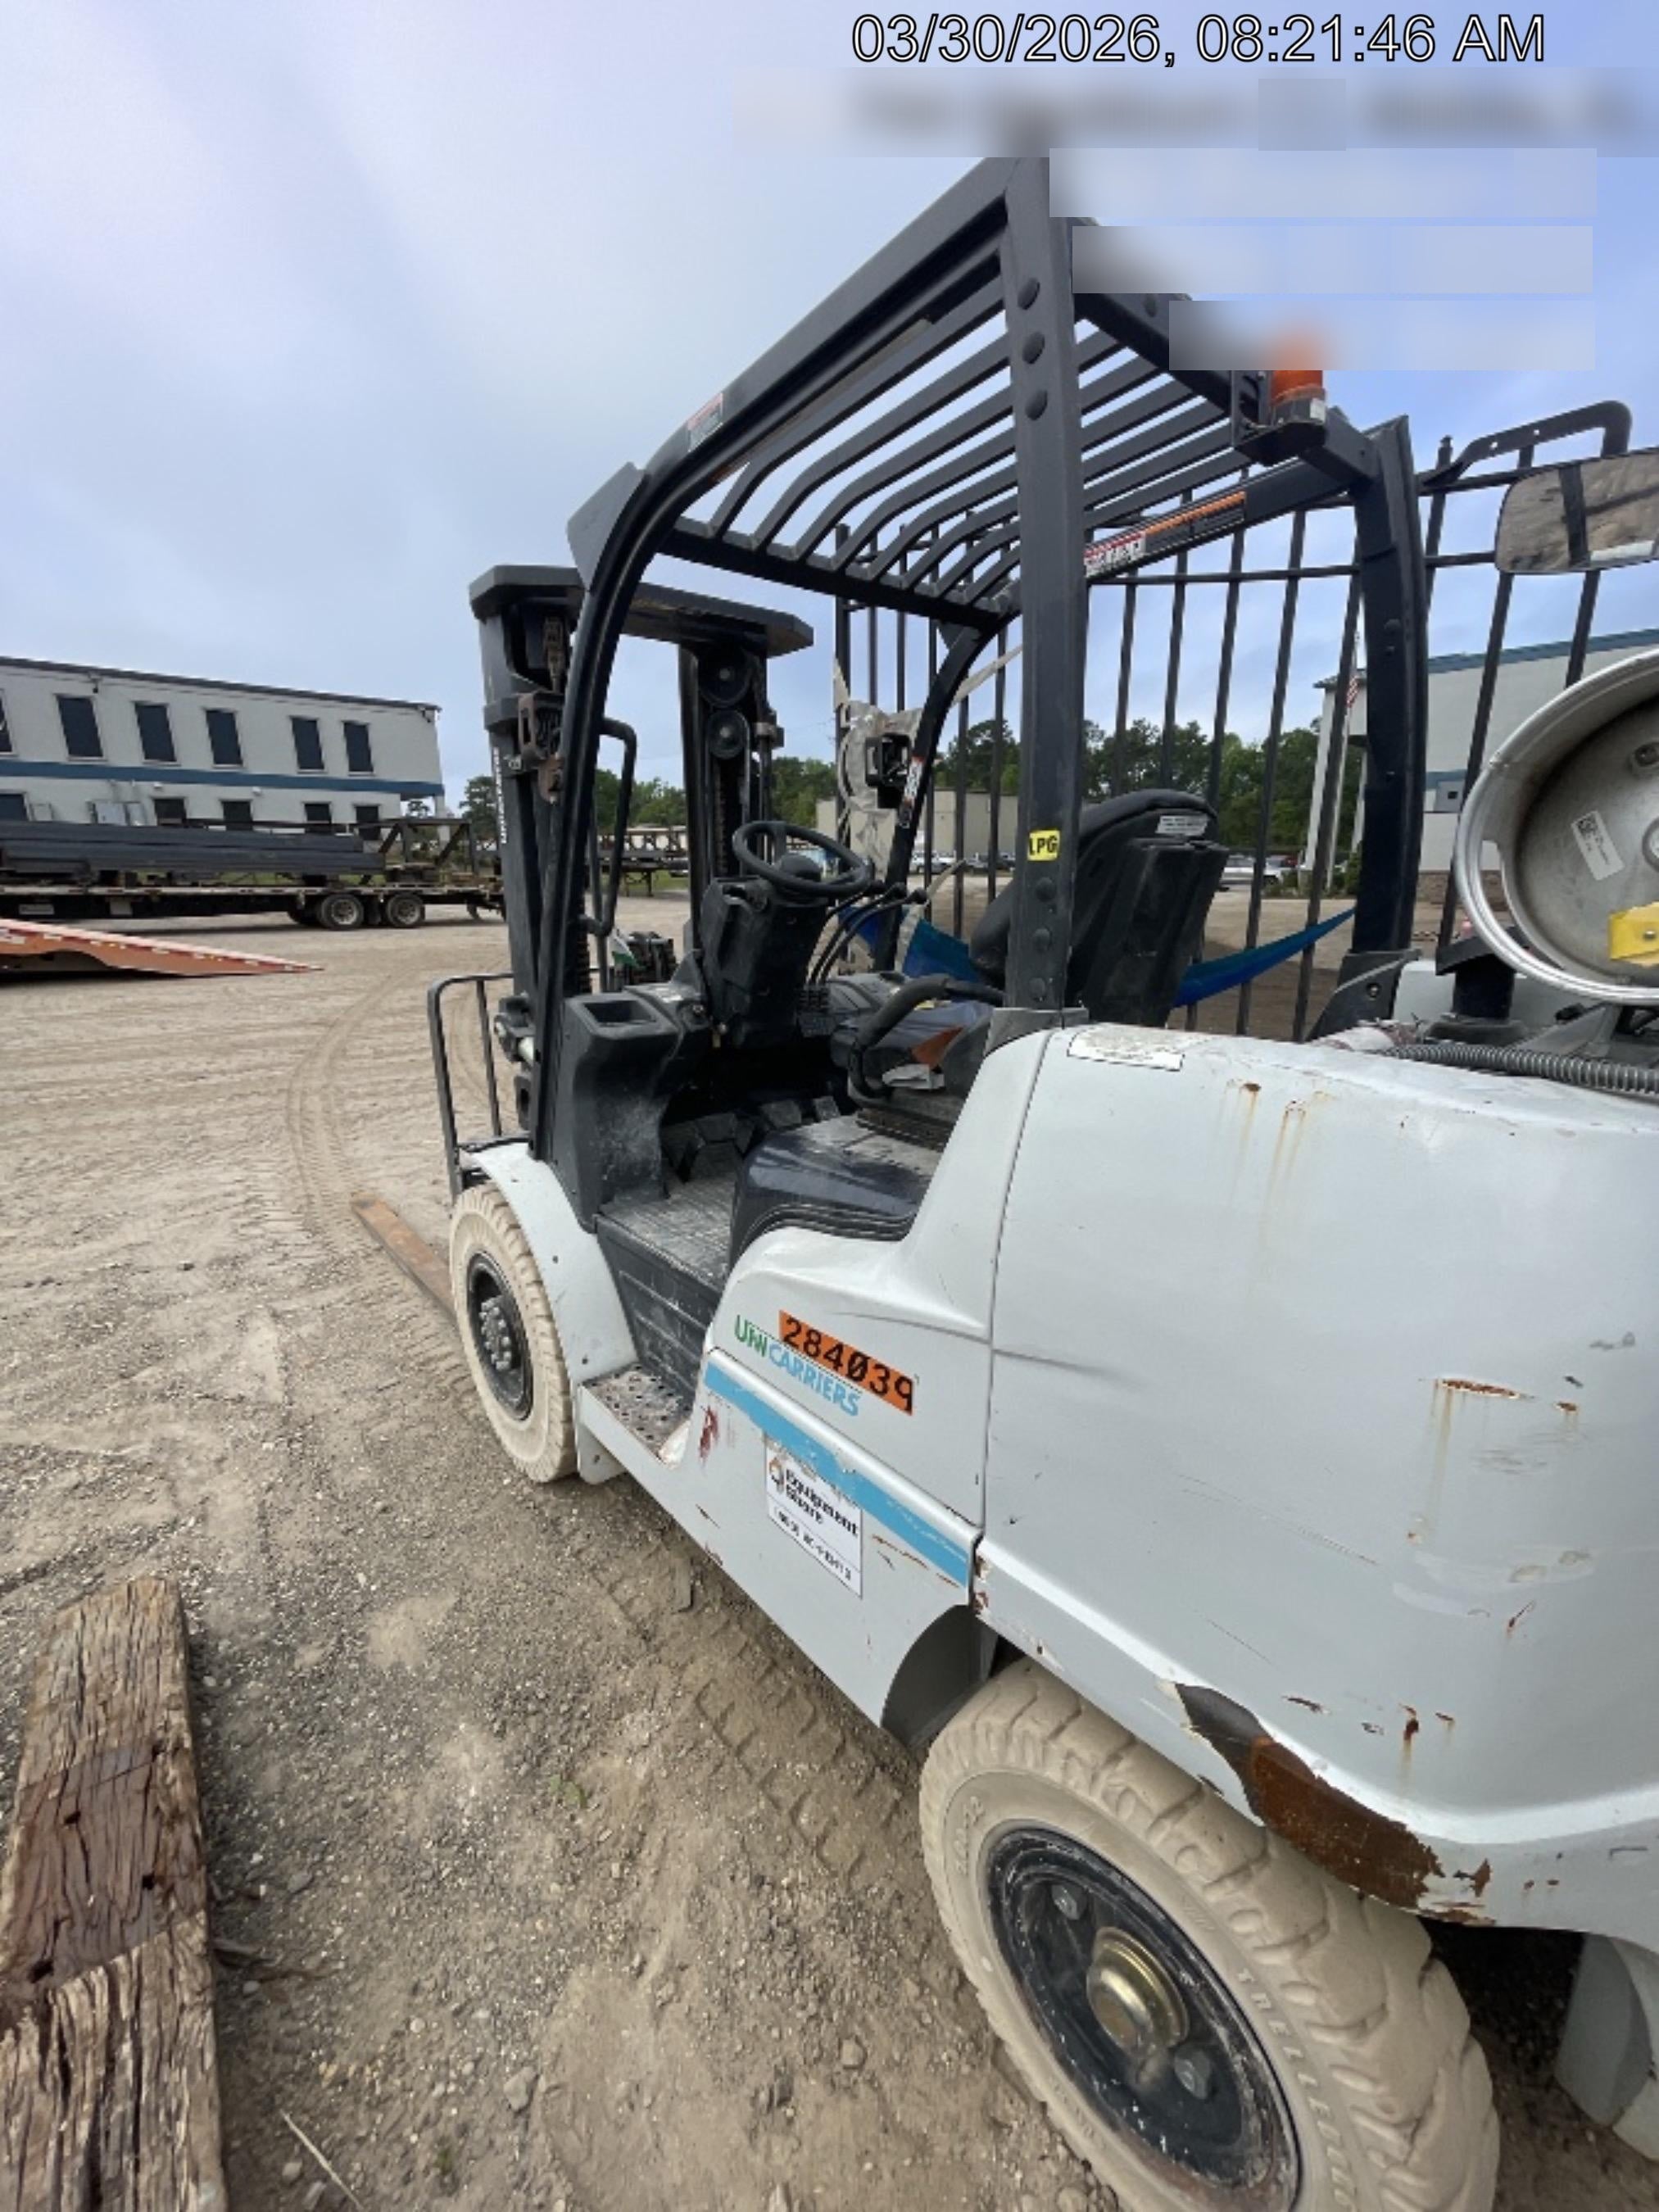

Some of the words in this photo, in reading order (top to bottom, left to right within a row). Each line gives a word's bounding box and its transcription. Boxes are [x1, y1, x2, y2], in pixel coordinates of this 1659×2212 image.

[1029, 836, 1058, 856] LPG
[782, 1316, 913, 1413] 284039
[786, 1468, 859, 1538] Equipment
